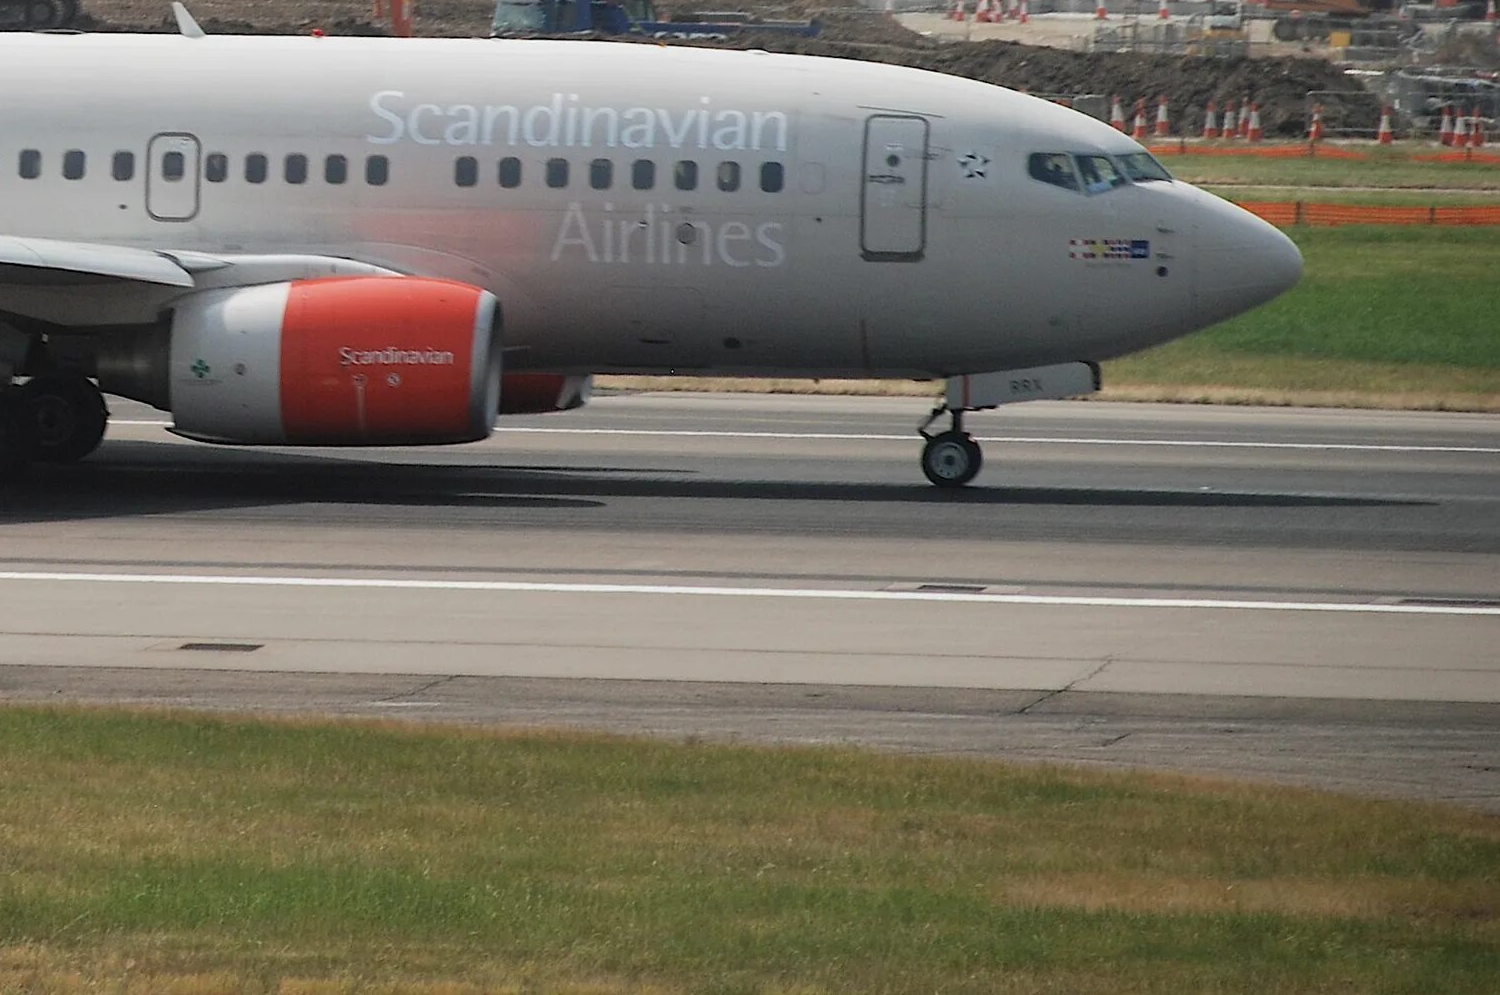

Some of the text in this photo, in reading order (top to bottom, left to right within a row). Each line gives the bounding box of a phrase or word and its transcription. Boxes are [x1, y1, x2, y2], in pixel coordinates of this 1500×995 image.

[367, 91, 788, 151] Scandinavian
[550, 203, 785, 267] Airlines
[339, 347, 454, 366] Scandinavian
